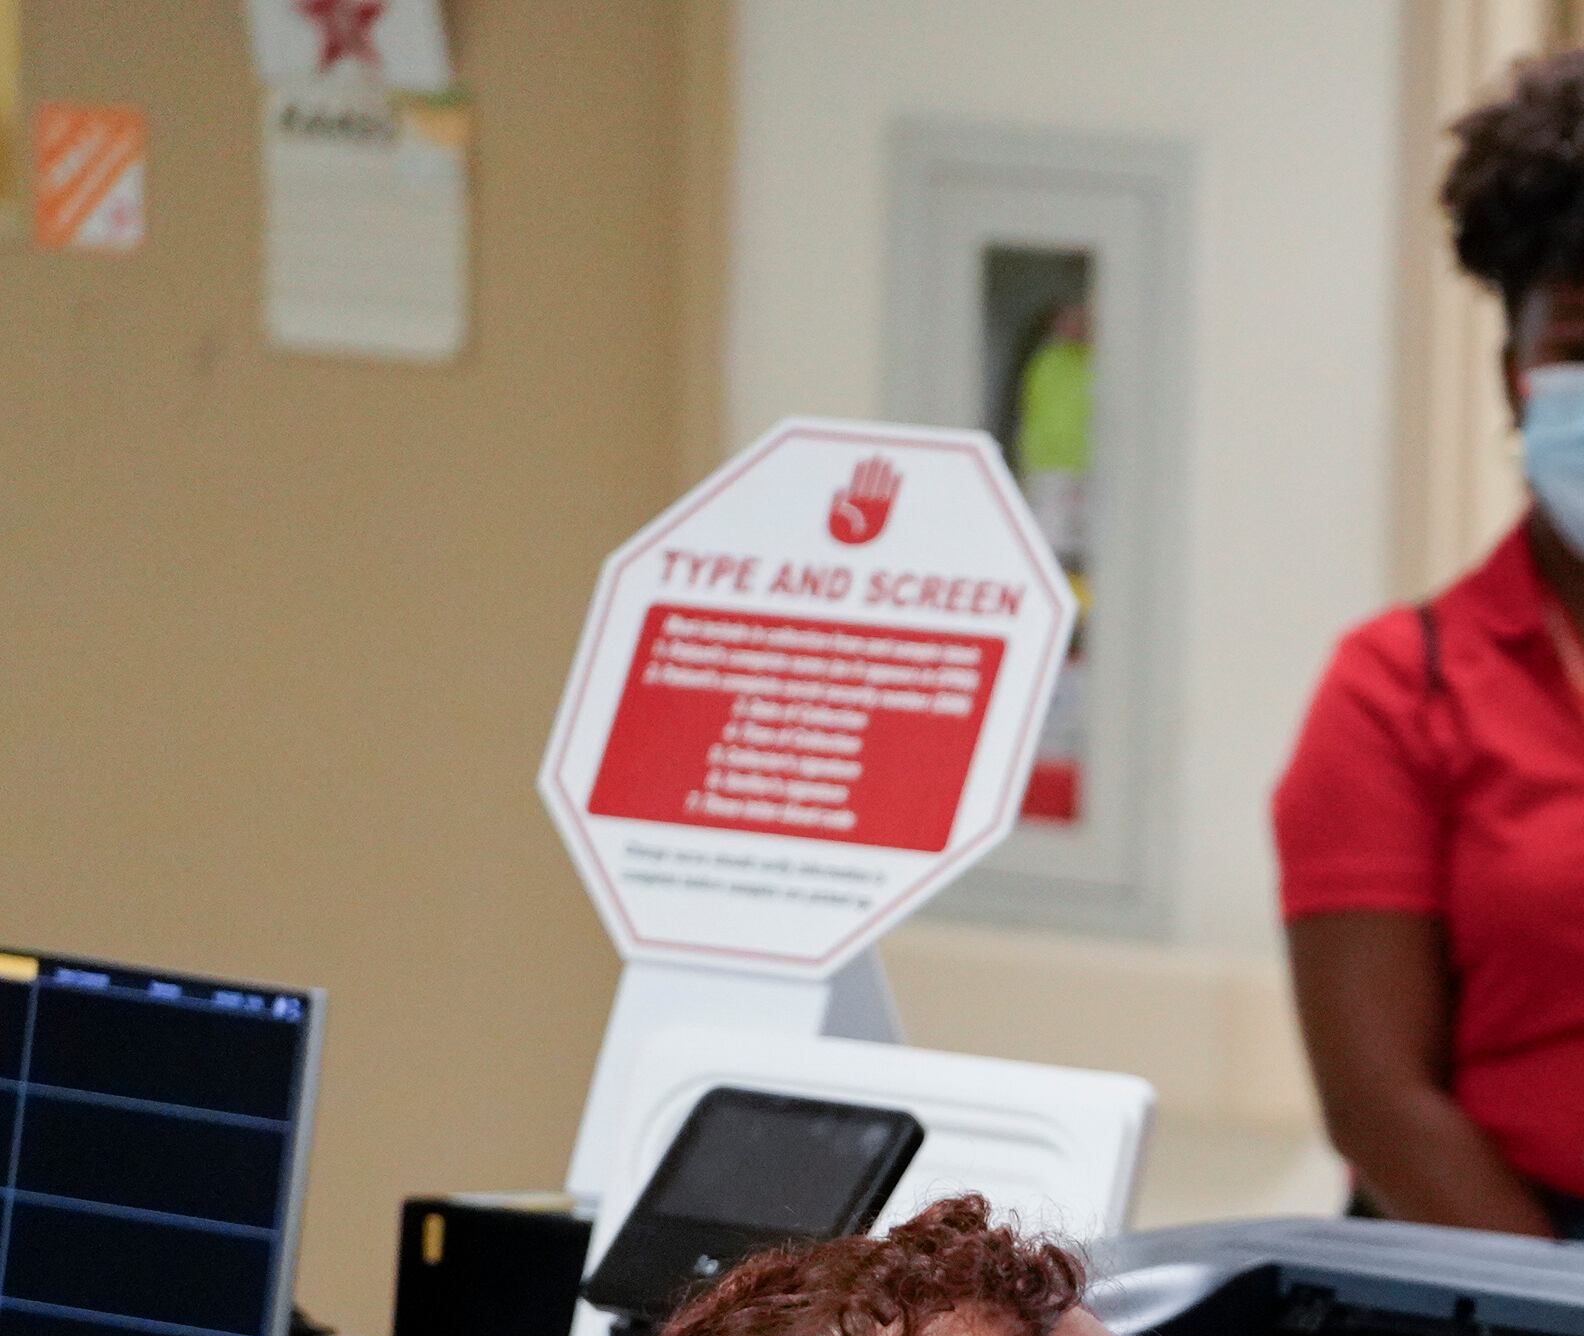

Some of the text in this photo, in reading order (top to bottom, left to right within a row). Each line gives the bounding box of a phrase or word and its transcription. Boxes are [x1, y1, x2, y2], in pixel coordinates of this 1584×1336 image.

[663, 551, 1024, 616] TYPE AND SCREEN
